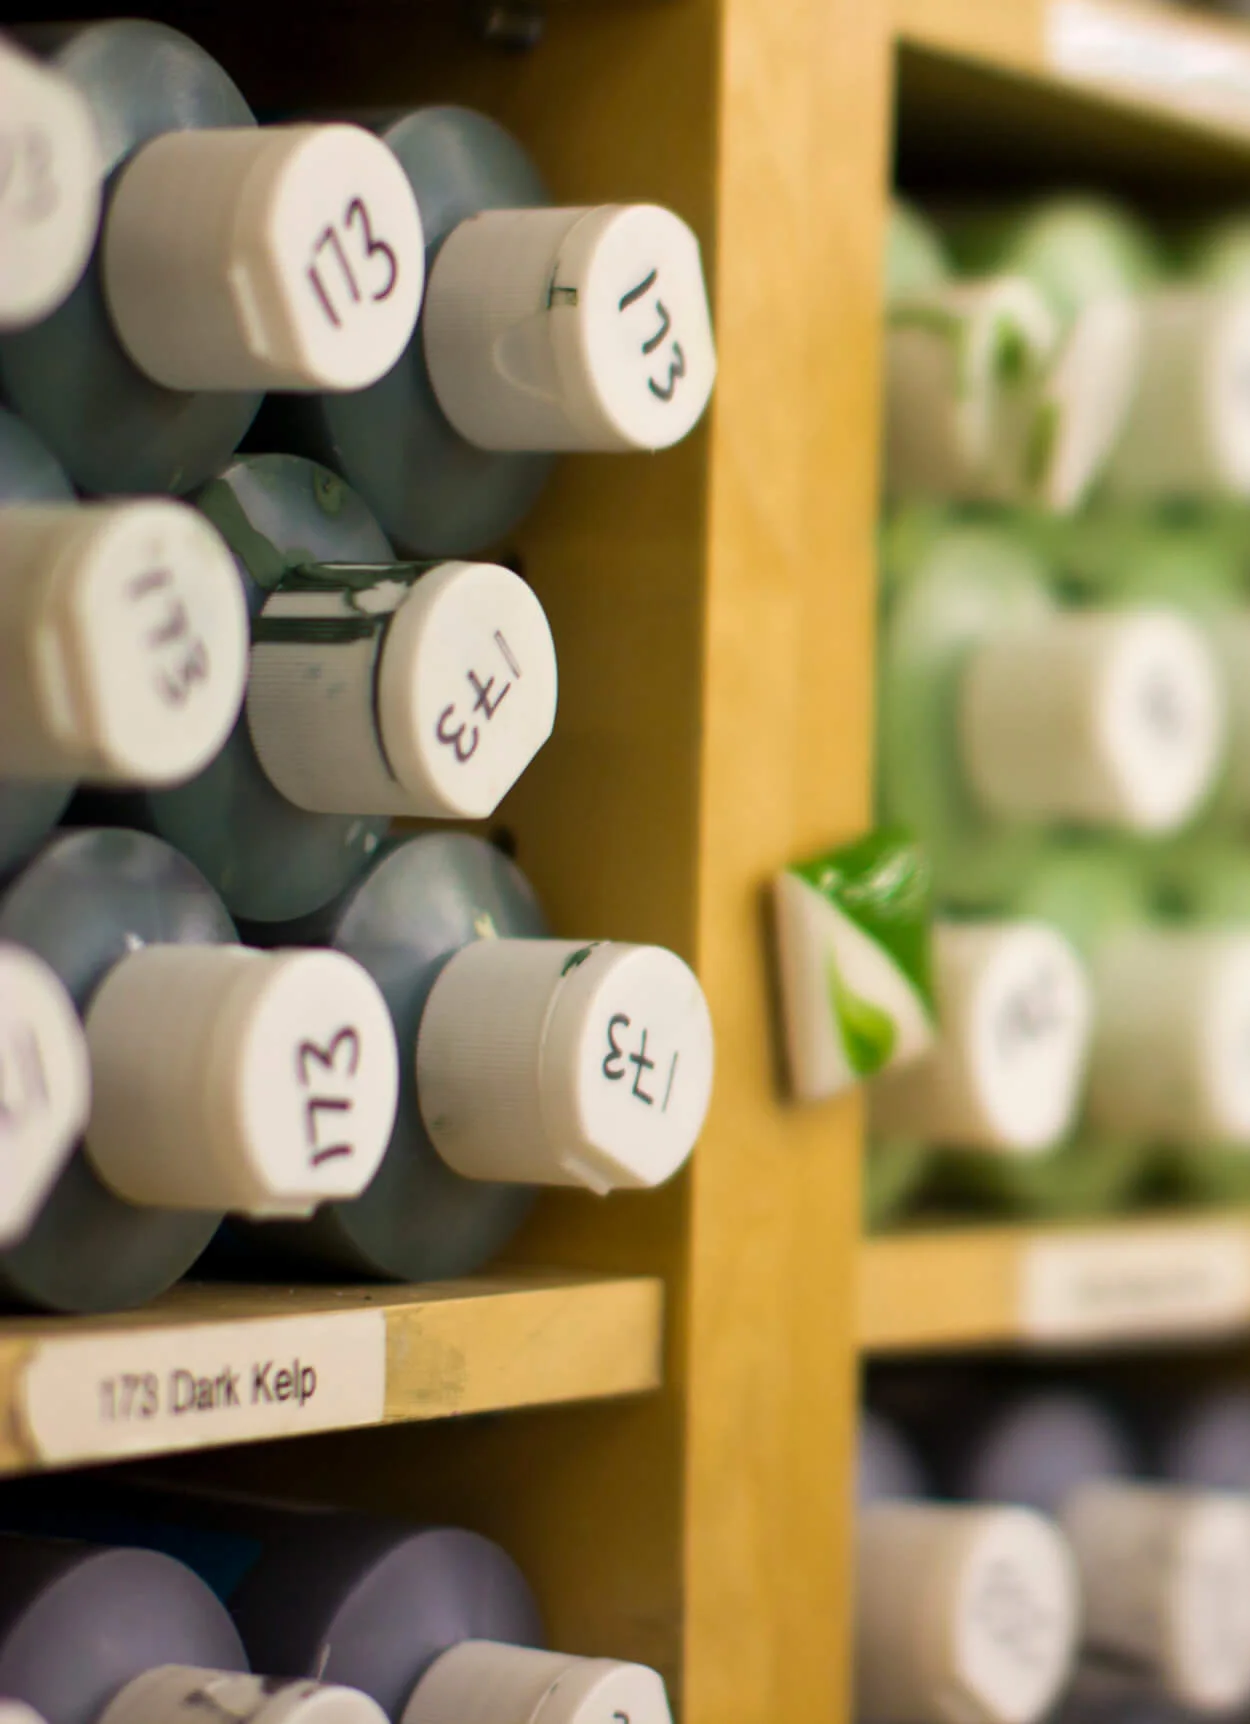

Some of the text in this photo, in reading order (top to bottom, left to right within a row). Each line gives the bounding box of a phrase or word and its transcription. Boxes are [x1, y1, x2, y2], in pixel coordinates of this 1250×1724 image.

[306, 196, 398, 329] 173
[618, 268, 687, 402] 173
[435, 630, 522, 763] 173
[297, 1025, 361, 1168] 173
[600, 1013, 679, 1112] 173
[98, 1357, 317, 1422] 173 Dark Kelp
